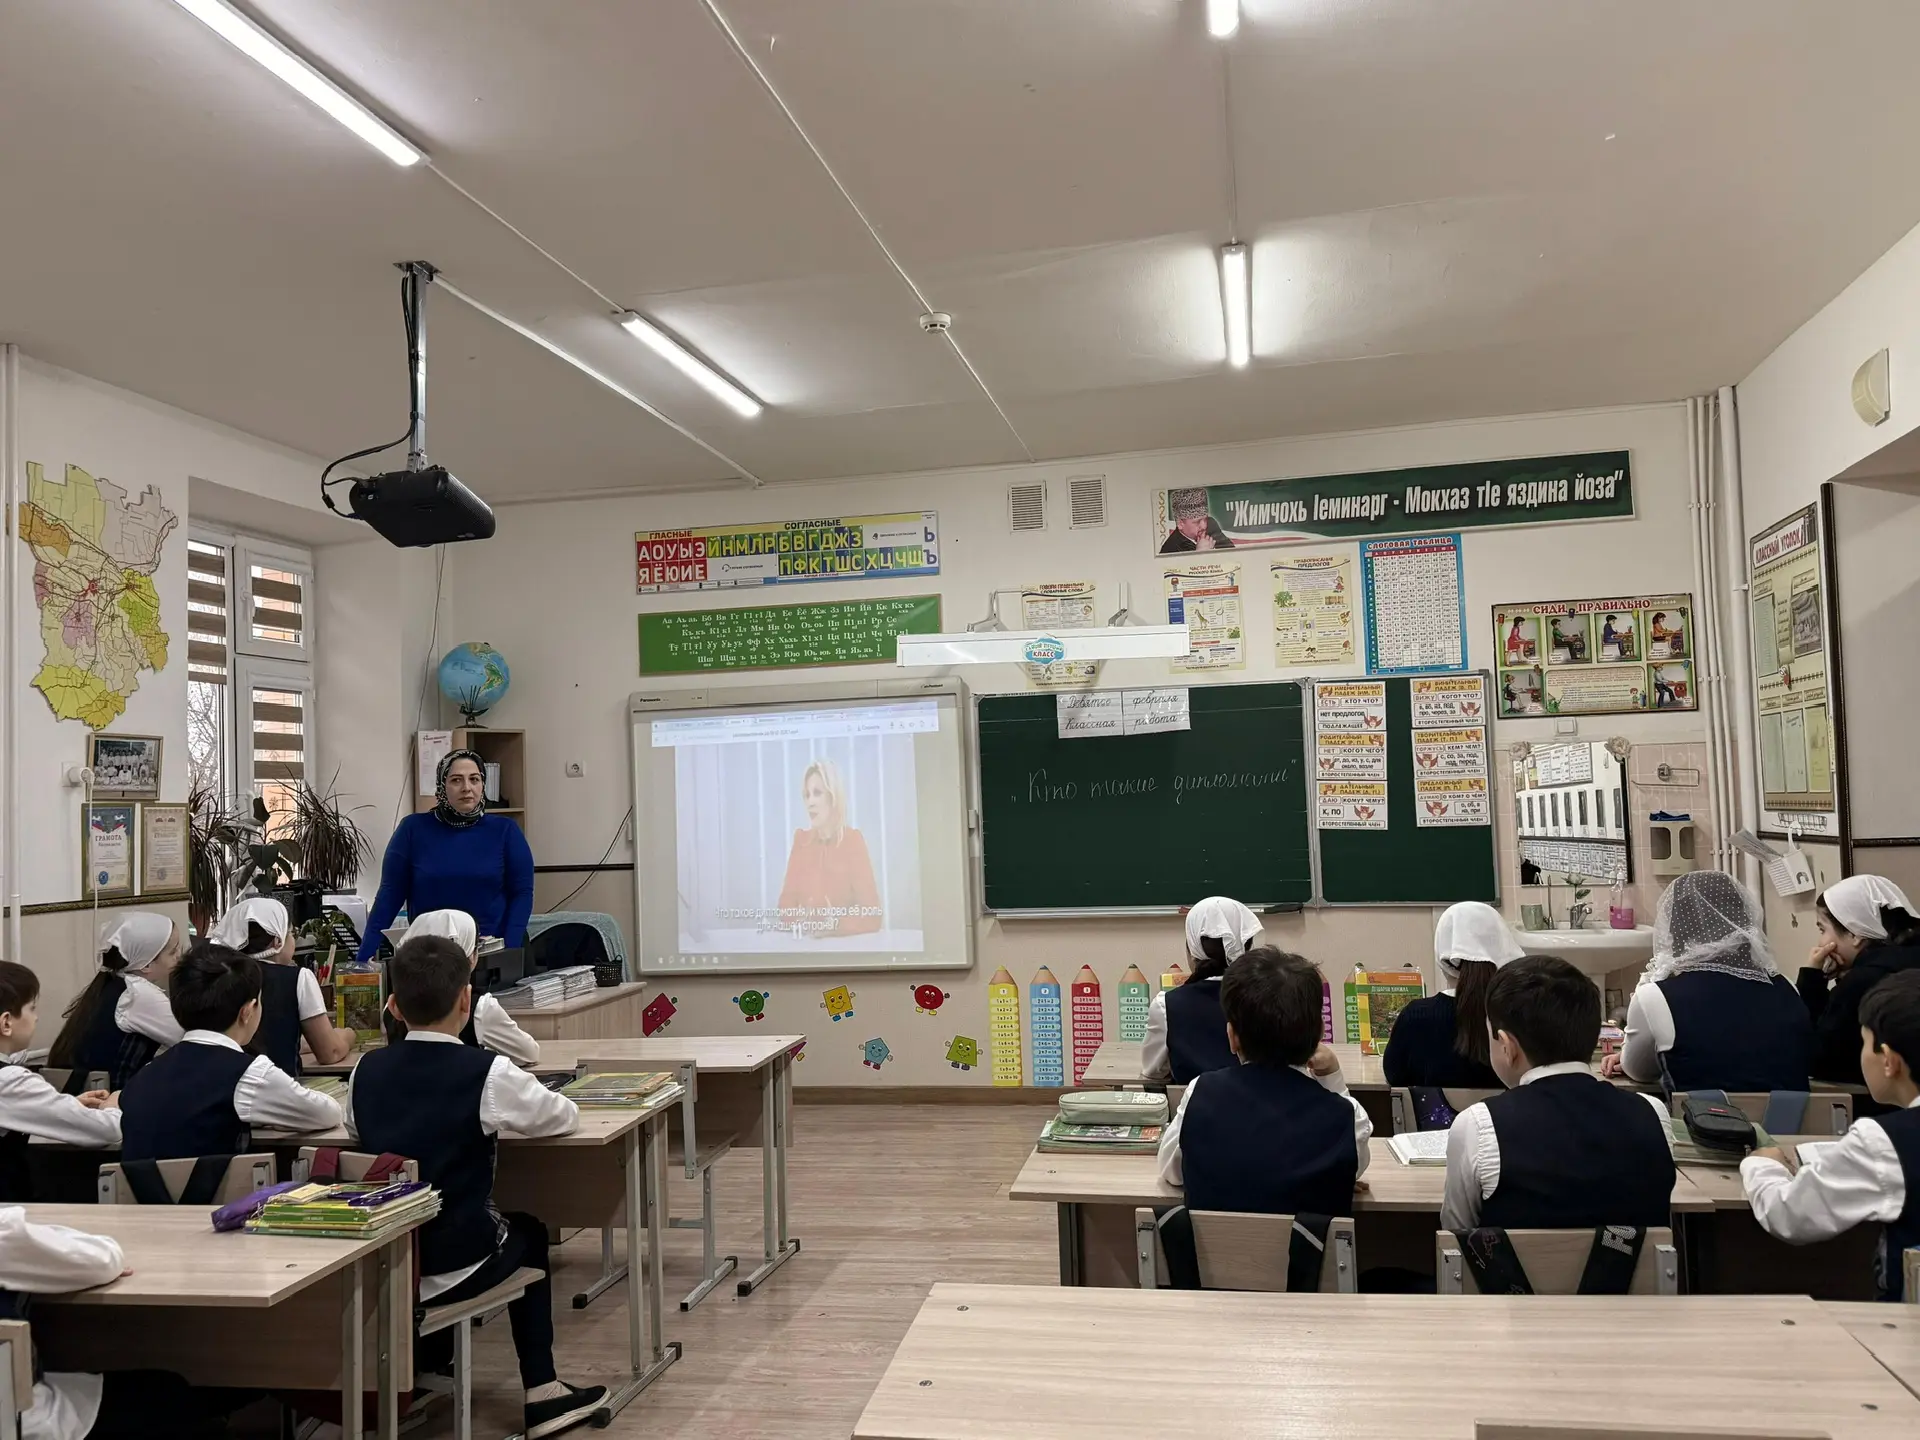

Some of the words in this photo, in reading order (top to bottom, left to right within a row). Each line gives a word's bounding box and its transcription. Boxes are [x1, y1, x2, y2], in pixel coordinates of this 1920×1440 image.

[1404, 486, 1470, 514] Мокхаз
[1506, 479, 1568, 508] яздина
[784, 519, 841, 530] СОГЛАСНЫЕ
[649, 530, 692, 540] ГЛАСНЫЕ
[1368, 540, 1410, 550] СЛОГОВАЯ
[1413, 538, 1452, 546] ТАБЛИЦА
[1533, 604, 1567, 614] СИДИ
[1578, 599, 1650, 613] ПРАВИЛЬНО
[1066, 718, 1116, 730] Классная
[1133, 713, 1177, 731] работа
